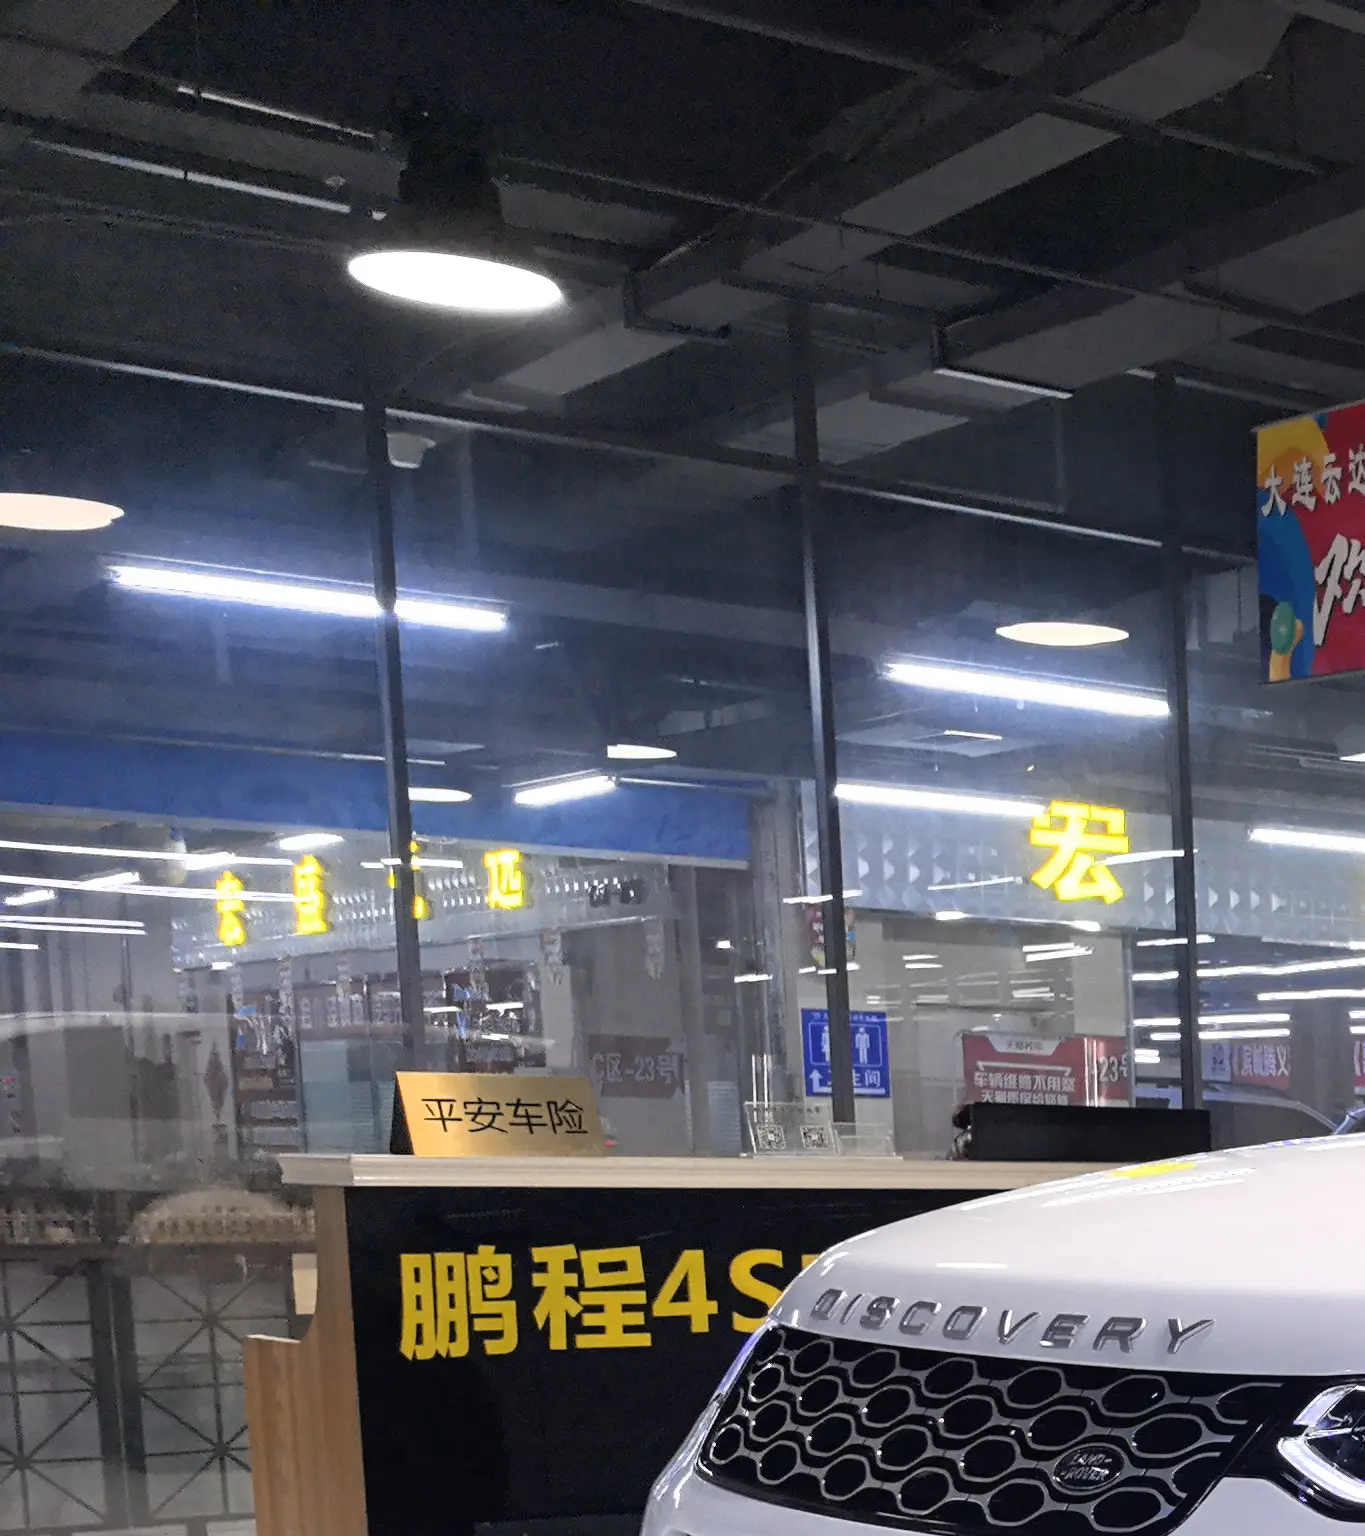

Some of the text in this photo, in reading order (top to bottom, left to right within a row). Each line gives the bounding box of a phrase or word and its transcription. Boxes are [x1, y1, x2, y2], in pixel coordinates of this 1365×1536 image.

[422, 1097, 588, 1136] 平安车险
[400, 1244, 826, 1361] 鹏程4S
[809, 1288, 1215, 1355] DISCOVERY
